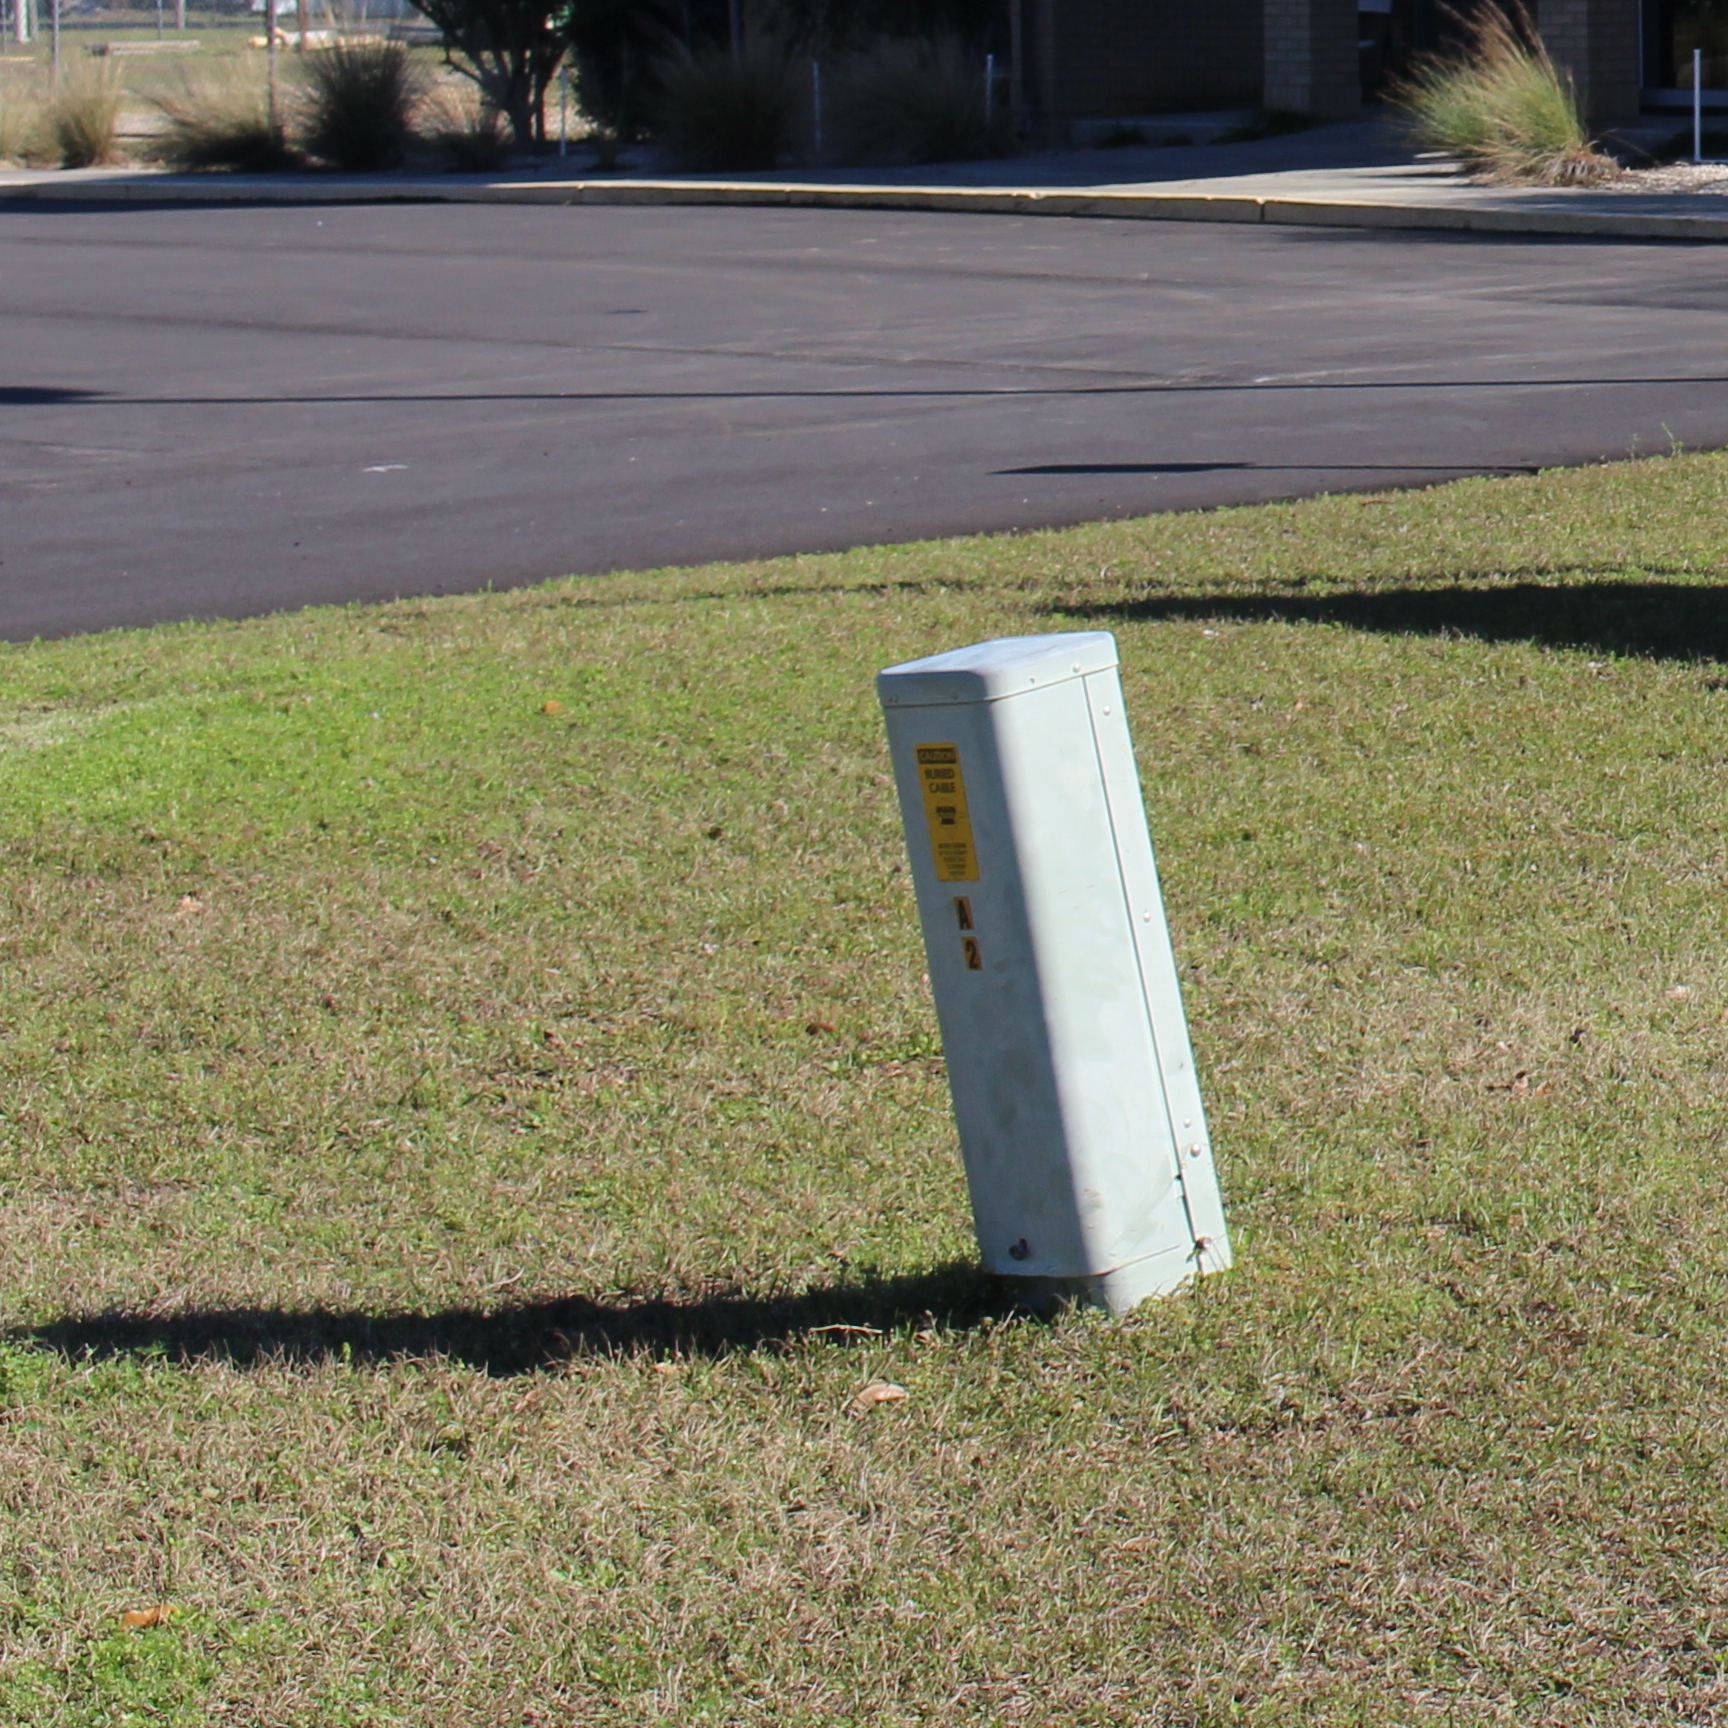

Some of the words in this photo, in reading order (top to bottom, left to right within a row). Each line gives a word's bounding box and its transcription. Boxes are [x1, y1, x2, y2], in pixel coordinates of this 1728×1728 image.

[920, 751, 956, 761] CAUTION
[924, 768, 955, 779] BURIED
[929, 782, 956, 793] CABLE
[957, 900, 970, 930] A
[965, 939, 978, 969] 2
